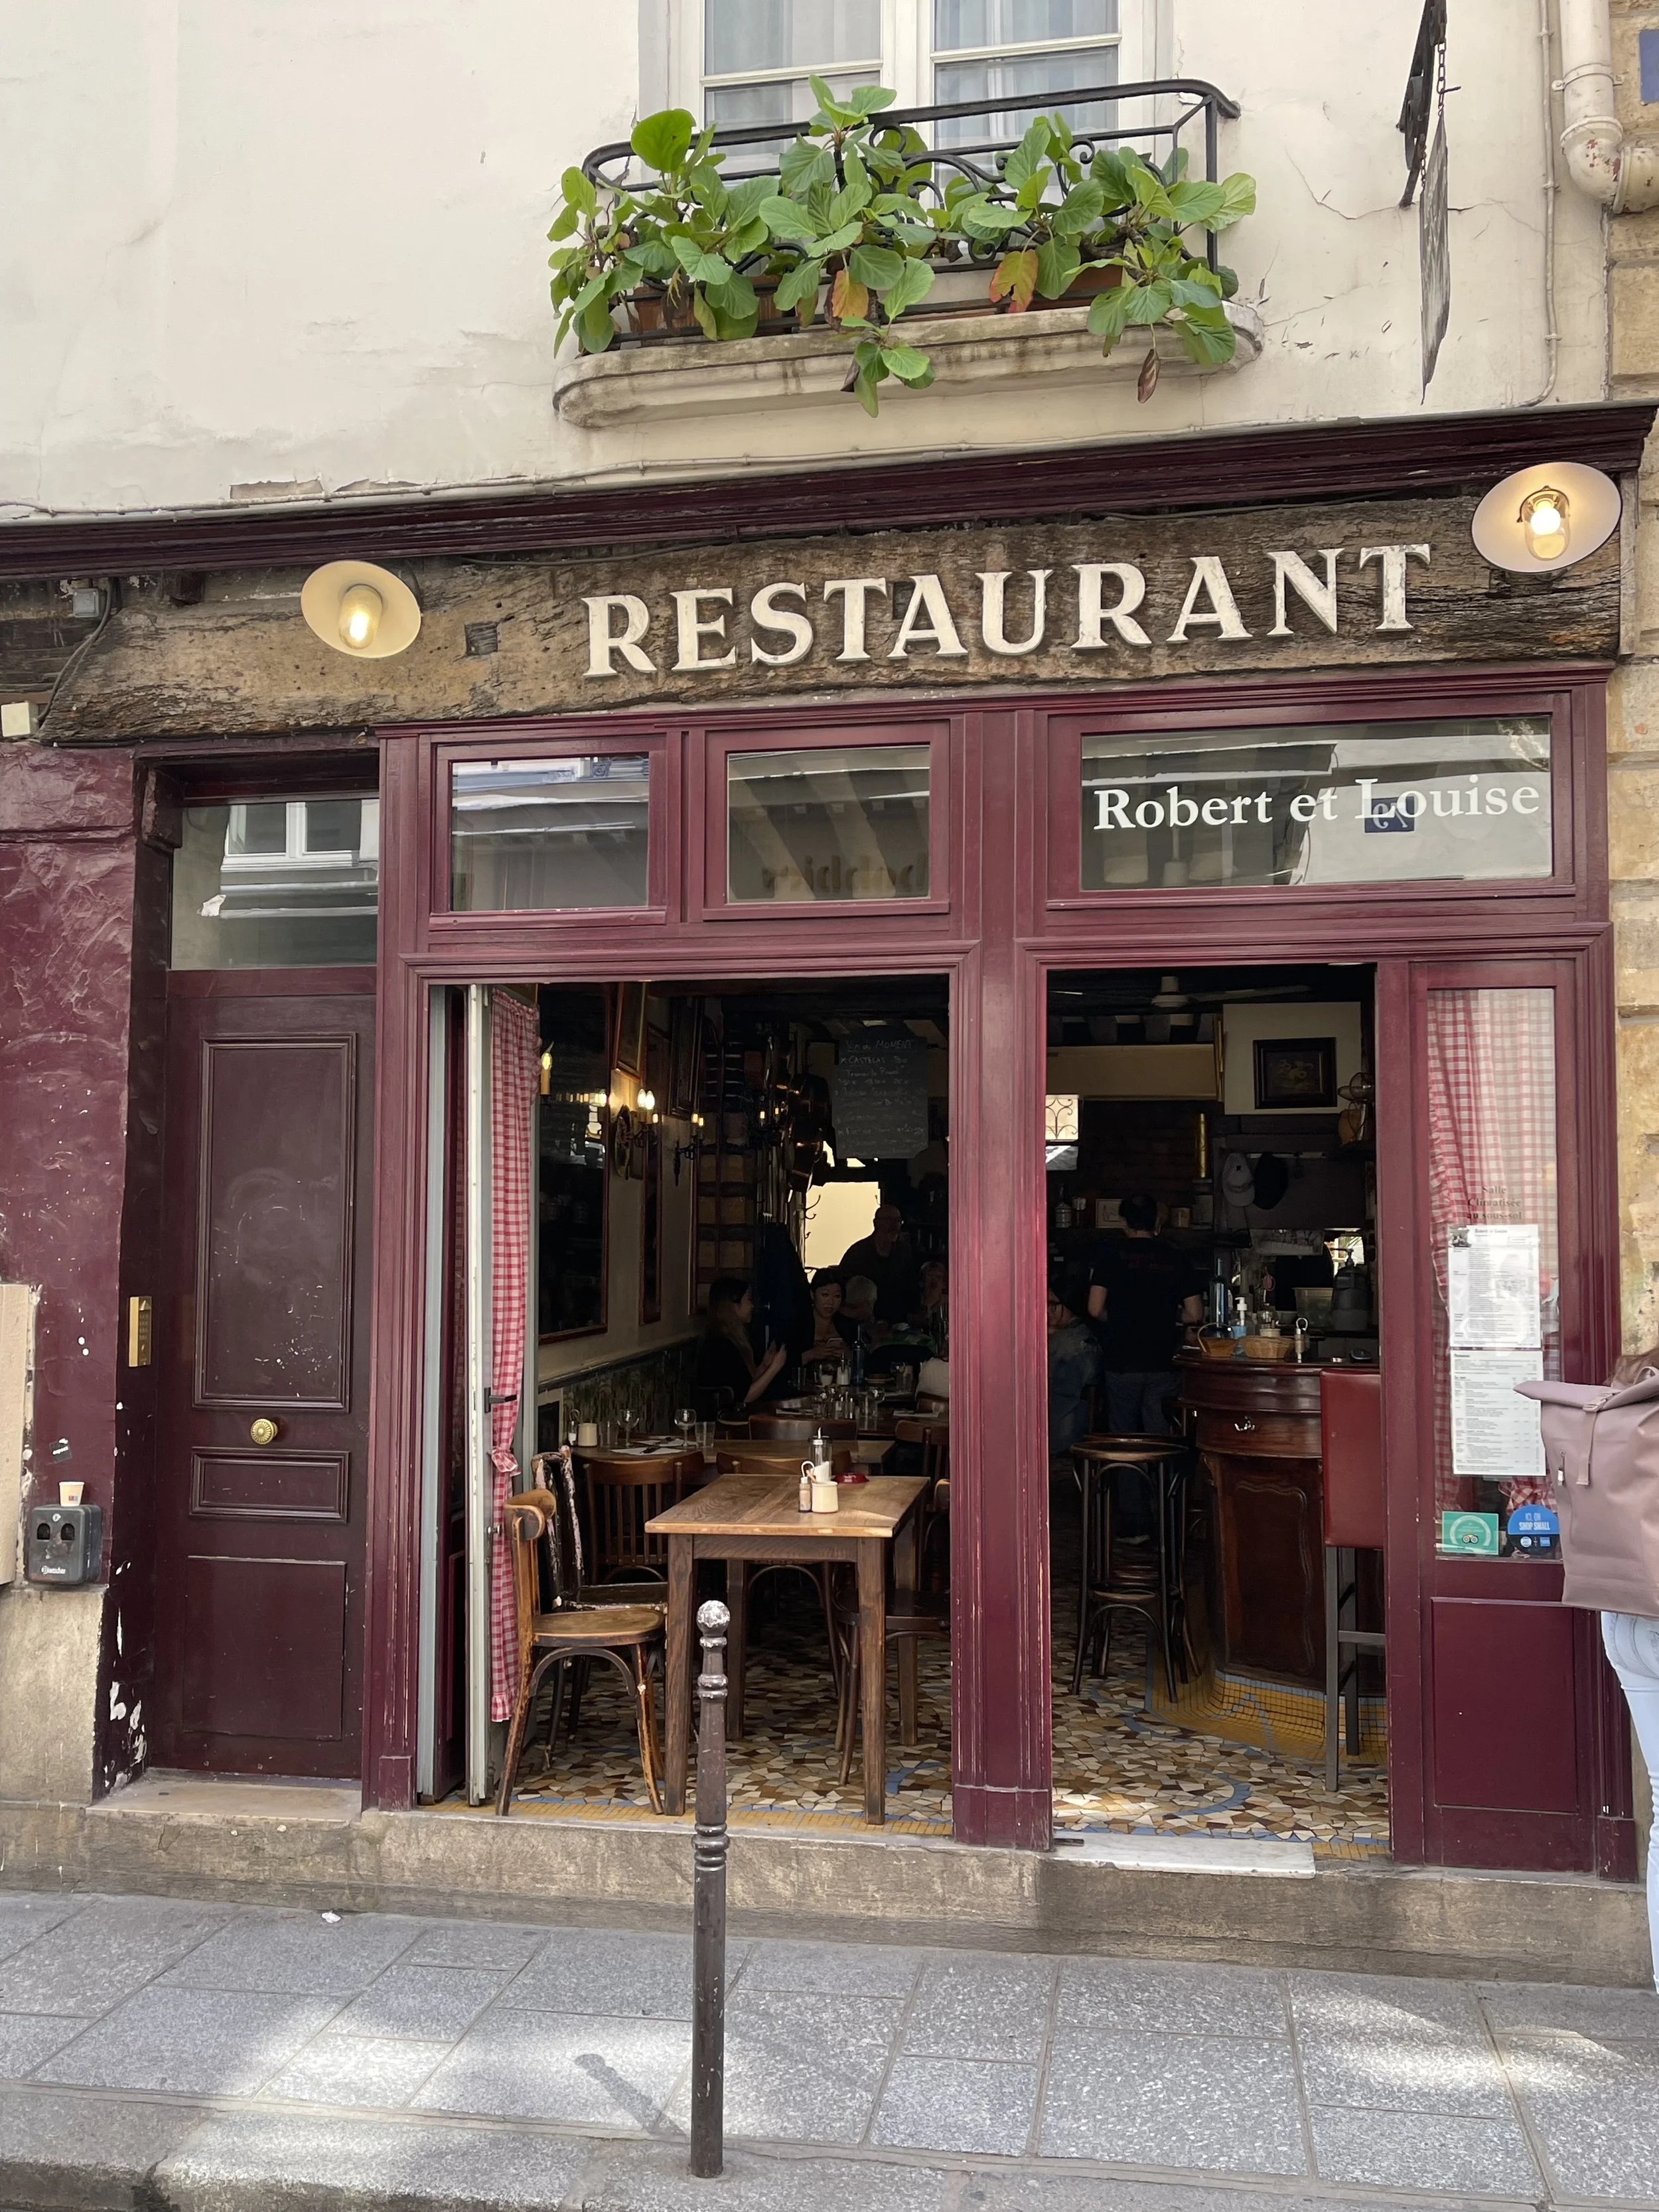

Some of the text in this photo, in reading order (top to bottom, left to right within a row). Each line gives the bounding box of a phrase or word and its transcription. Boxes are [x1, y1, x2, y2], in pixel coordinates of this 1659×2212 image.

[581, 543, 1431, 679] RESTAURANT
[1093, 774, 1540, 831] Robert et Louise
[1468, 1197, 1522, 1207] Climatisée
[1519, 1521, 1550, 1530] SHOP SMALL
